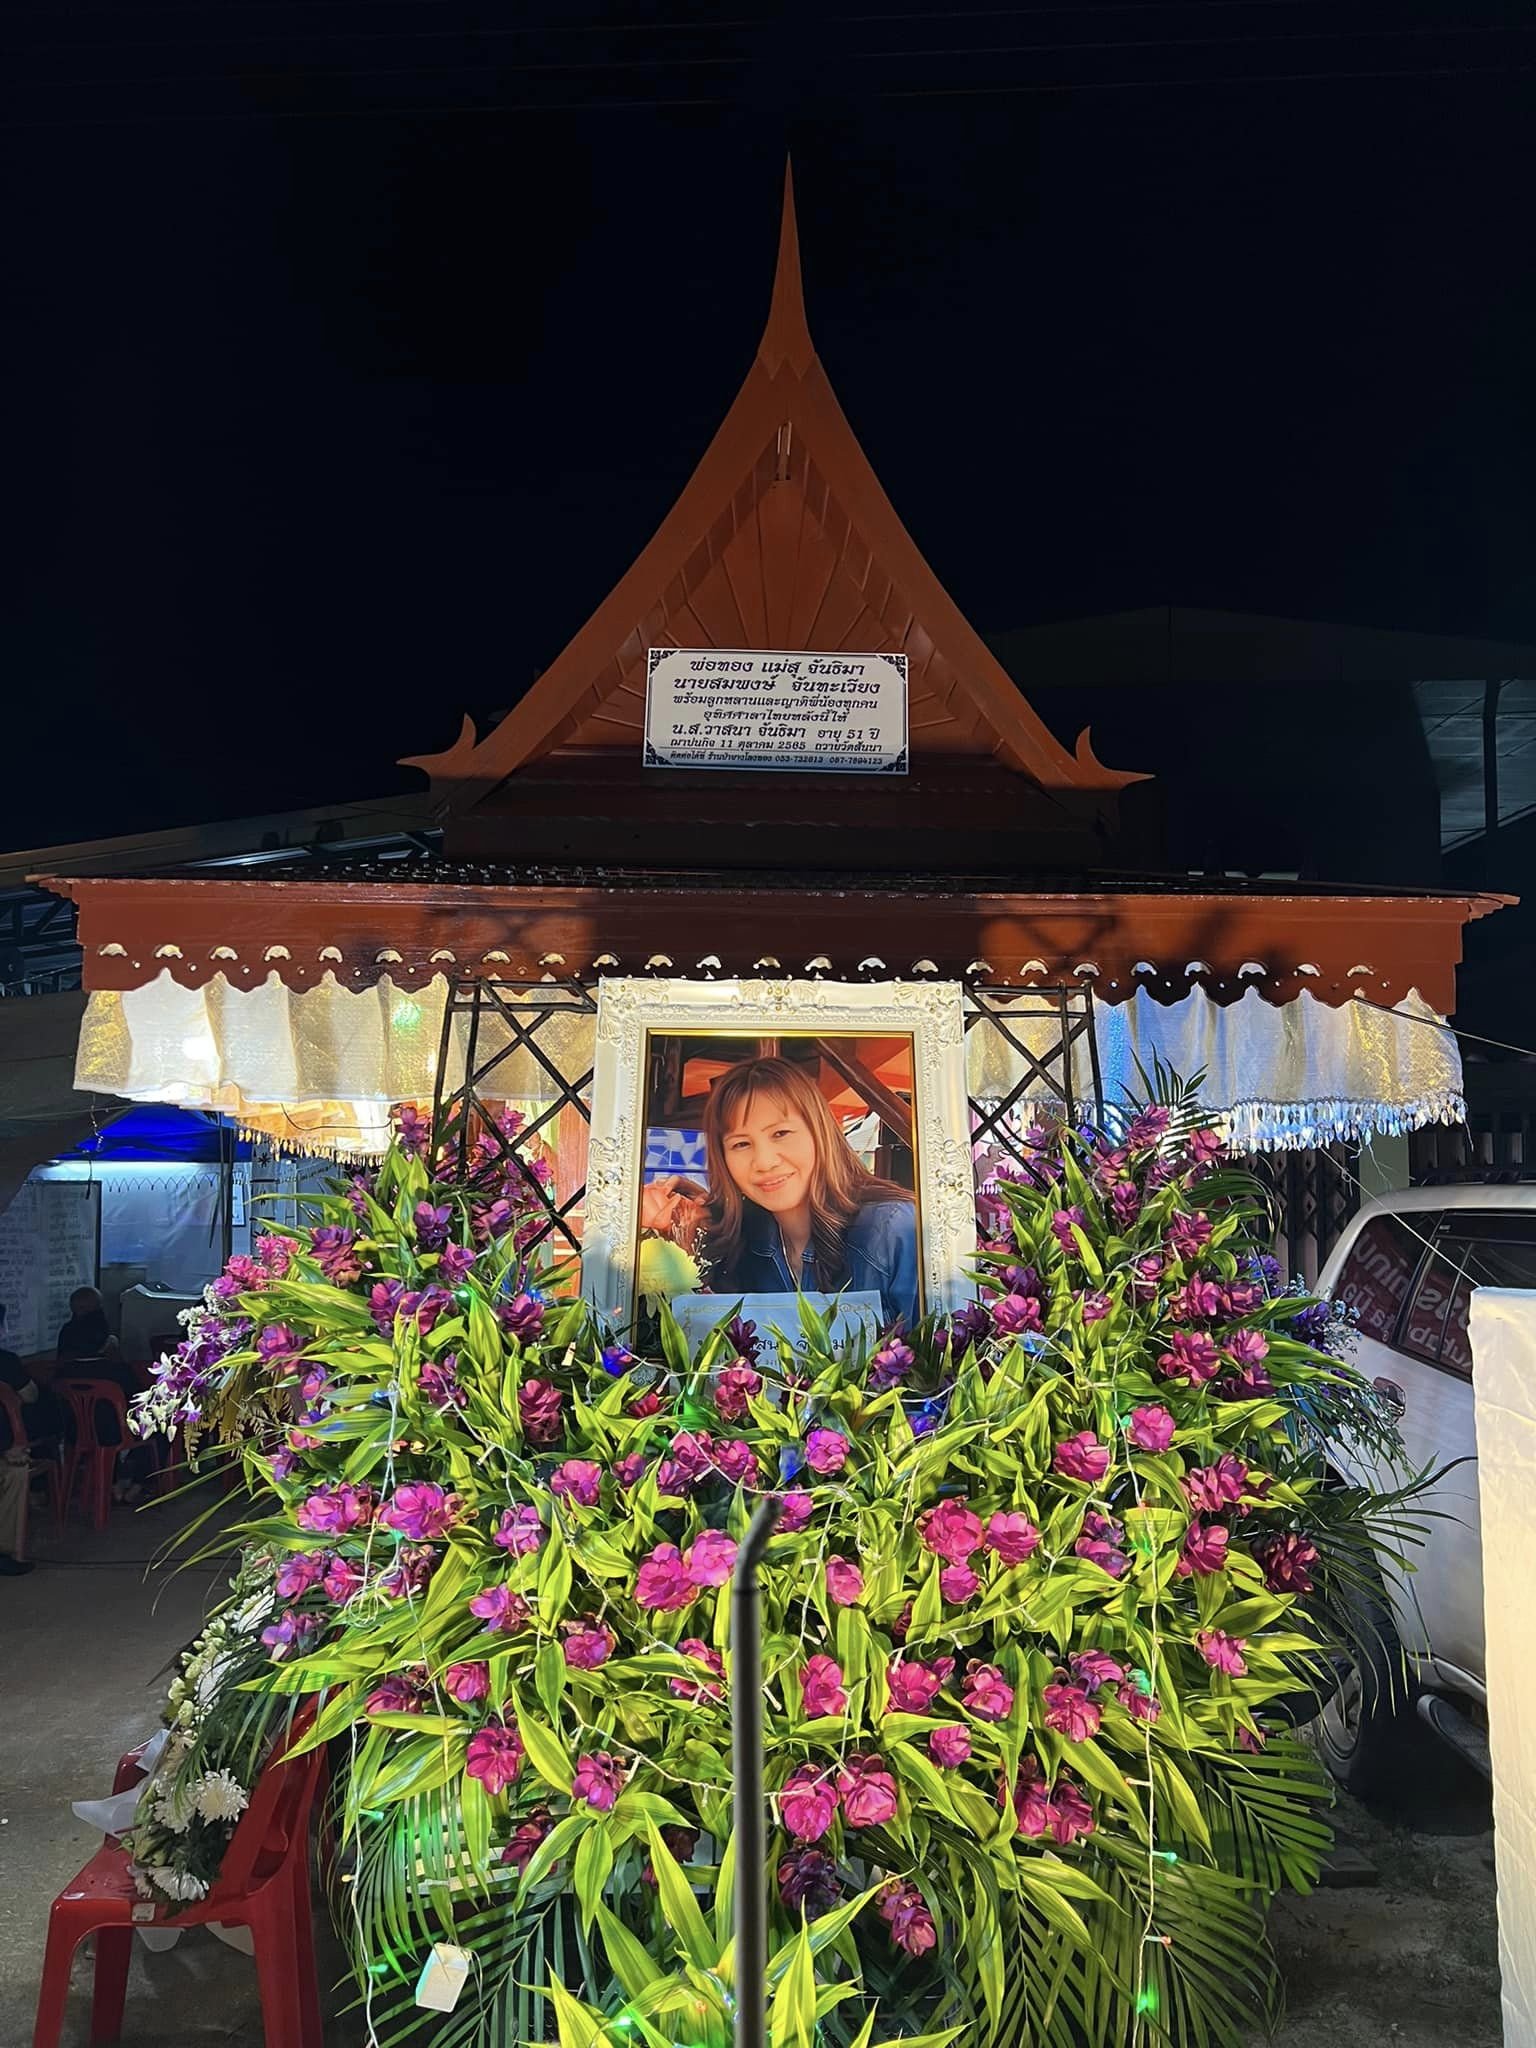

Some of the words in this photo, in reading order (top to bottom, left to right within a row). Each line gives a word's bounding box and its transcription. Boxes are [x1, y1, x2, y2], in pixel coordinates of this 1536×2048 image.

[690, 657, 753, 672] พ่อทอง
[674, 674, 779, 690] นายสมพงษ์
[792, 676, 881, 693] จันทะเวียง
[673, 692, 878, 711] พร้อมลูกหลานและญาติพี่น้องทุกคน
[818, 729, 842, 742] อายุ
[847, 729, 863, 740] 51
[869, 728, 880, 740] ปี
[670, 737, 715, 748] ฌาปนกิจ
[720, 740, 732, 748] 11
[738, 740, 774, 751] ตุลาคม
[778, 741, 806, 750] 2565
